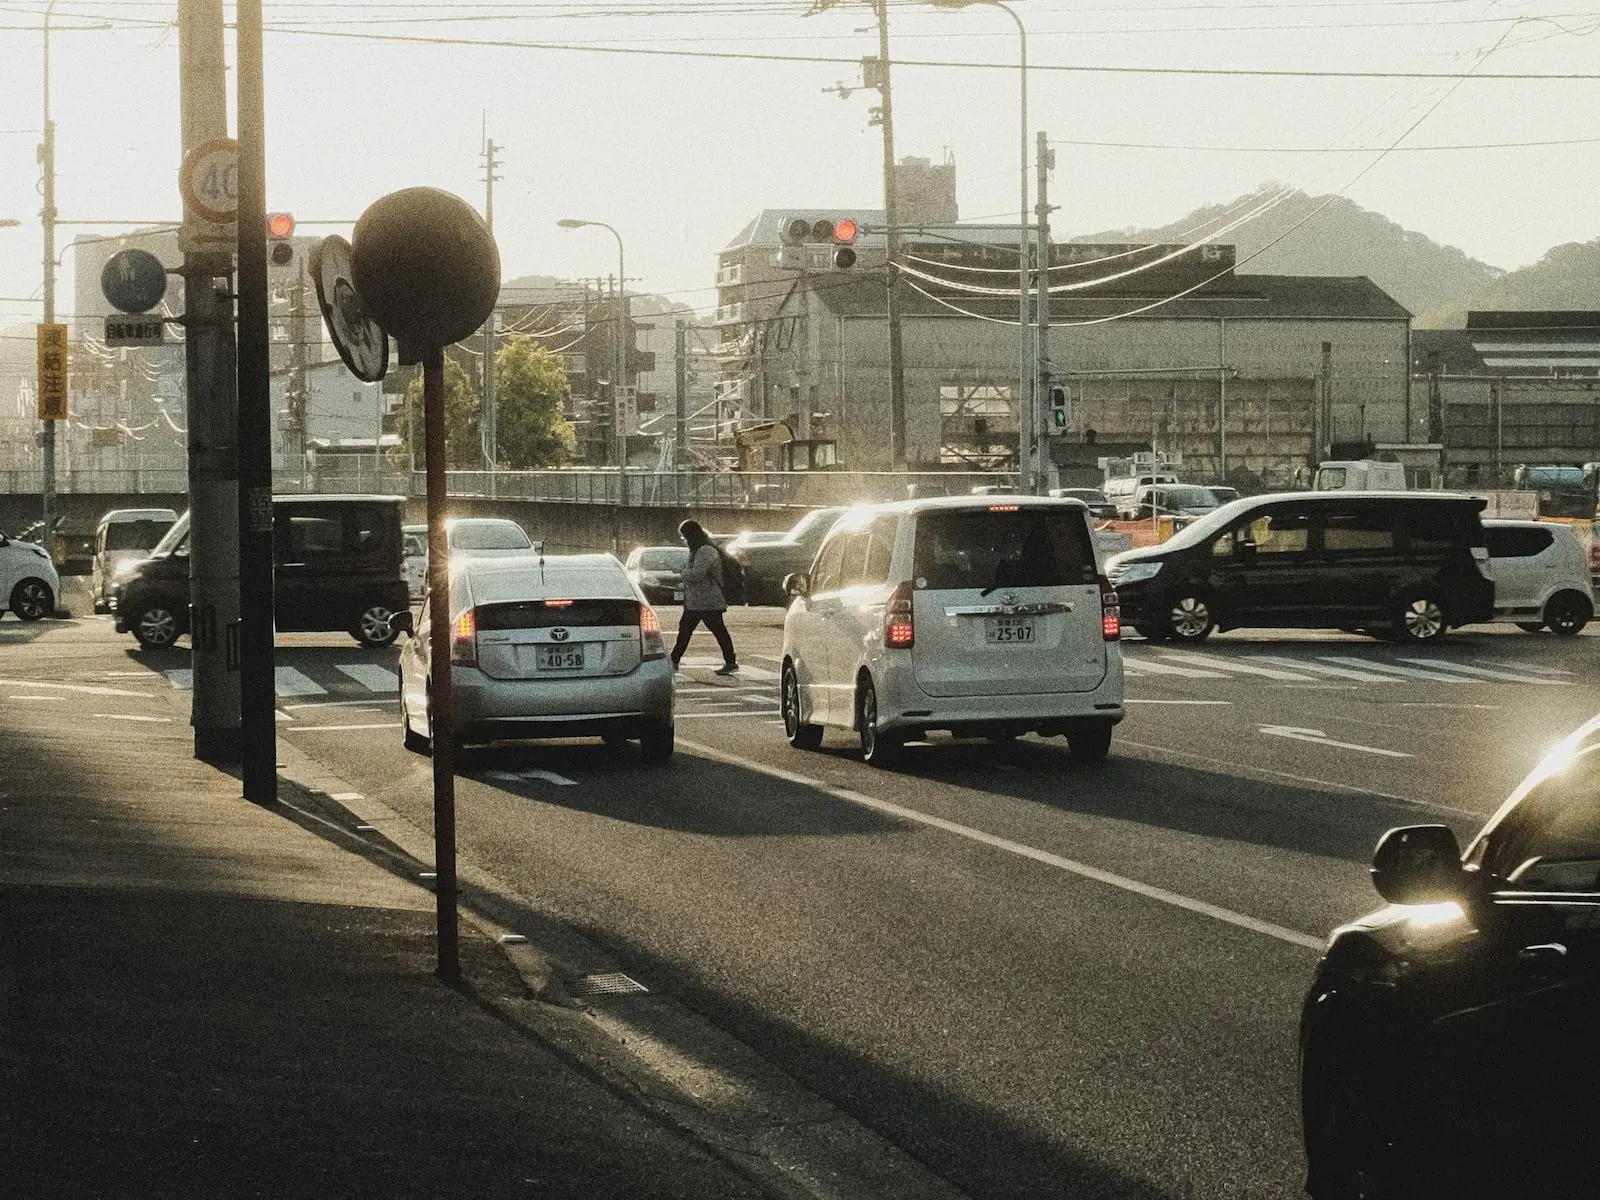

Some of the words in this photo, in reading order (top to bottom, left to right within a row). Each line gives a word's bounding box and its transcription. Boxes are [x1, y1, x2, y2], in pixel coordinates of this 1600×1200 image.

[201, 163, 238, 200] 40
[997, 626, 1032, 641] 25-07
[546, 654, 582, 667] 40-58
